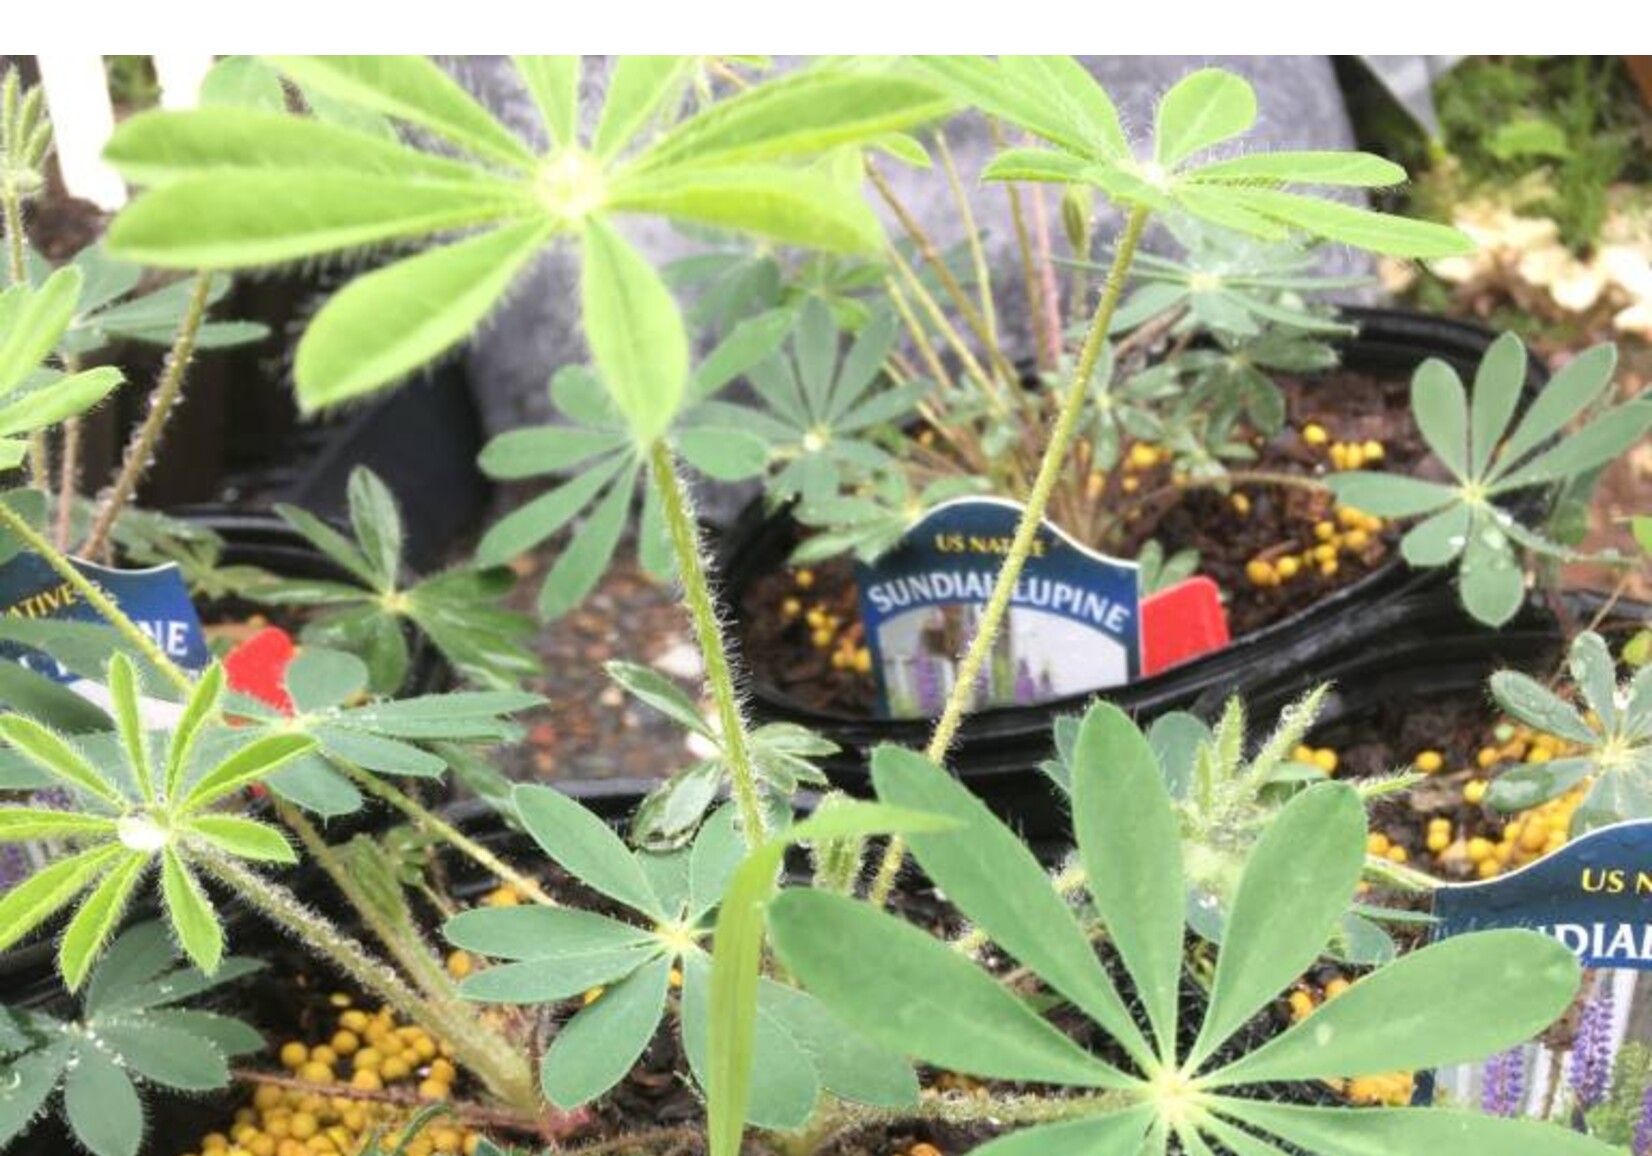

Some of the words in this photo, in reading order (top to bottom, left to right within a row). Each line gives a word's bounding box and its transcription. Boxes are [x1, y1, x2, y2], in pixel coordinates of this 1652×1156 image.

[936, 533, 965, 553] US
[969, 535, 1045, 557] NATE
[4, 581, 78, 618] ATIVE
[1582, 867, 1625, 893] US
